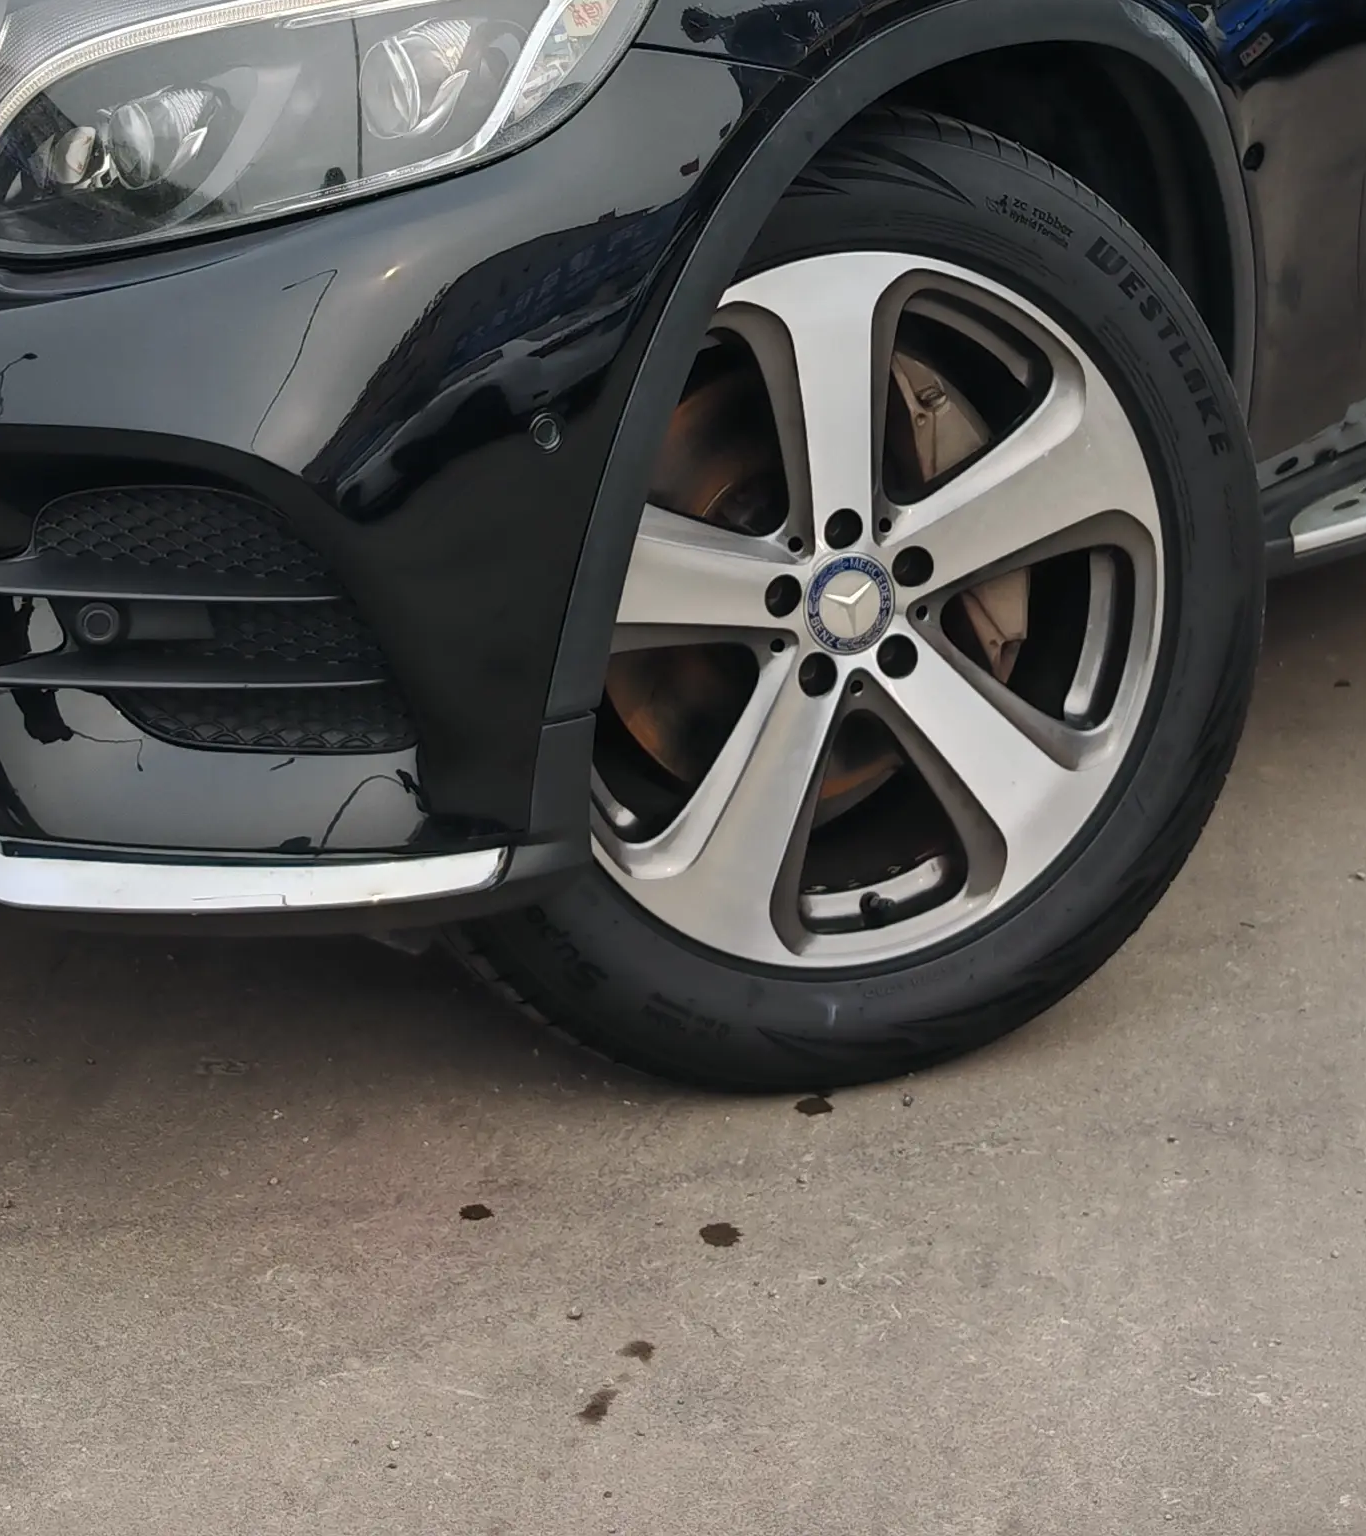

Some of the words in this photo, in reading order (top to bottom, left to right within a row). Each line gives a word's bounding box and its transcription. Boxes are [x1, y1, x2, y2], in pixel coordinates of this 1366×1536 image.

[1084, 235, 1233, 457] WESTLAKE
[849, 557, 891, 610] MERCEDES
[810, 616, 836, 647] BENZ
